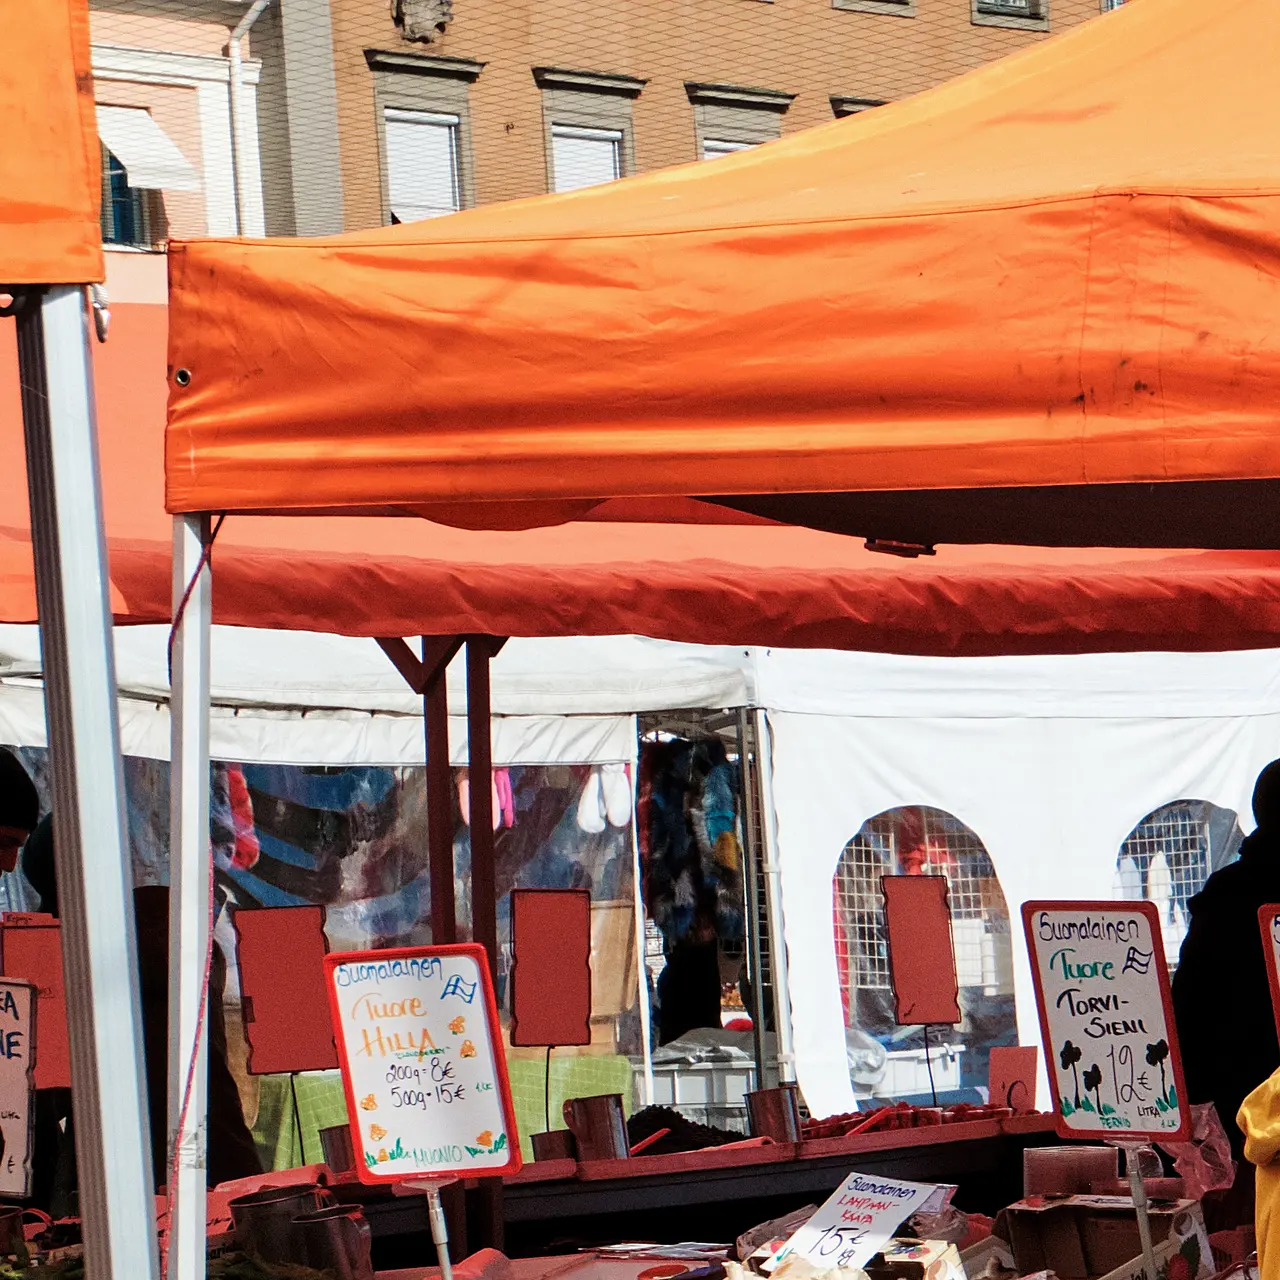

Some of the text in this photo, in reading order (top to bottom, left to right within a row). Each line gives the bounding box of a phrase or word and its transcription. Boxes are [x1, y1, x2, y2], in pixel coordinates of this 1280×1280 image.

[1039, 911, 1140, 944] Suomalainen
[336, 956, 444, 988] Suomalainen
[1050, 948, 1116, 981] Tuore
[352, 992, 428, 1021] Tuore
[1083, 1017, 1148, 1039] SIENI
[413, 1144, 464, 1169] MUONIO
[847, 1176, 917, 1202] Suomalainen
